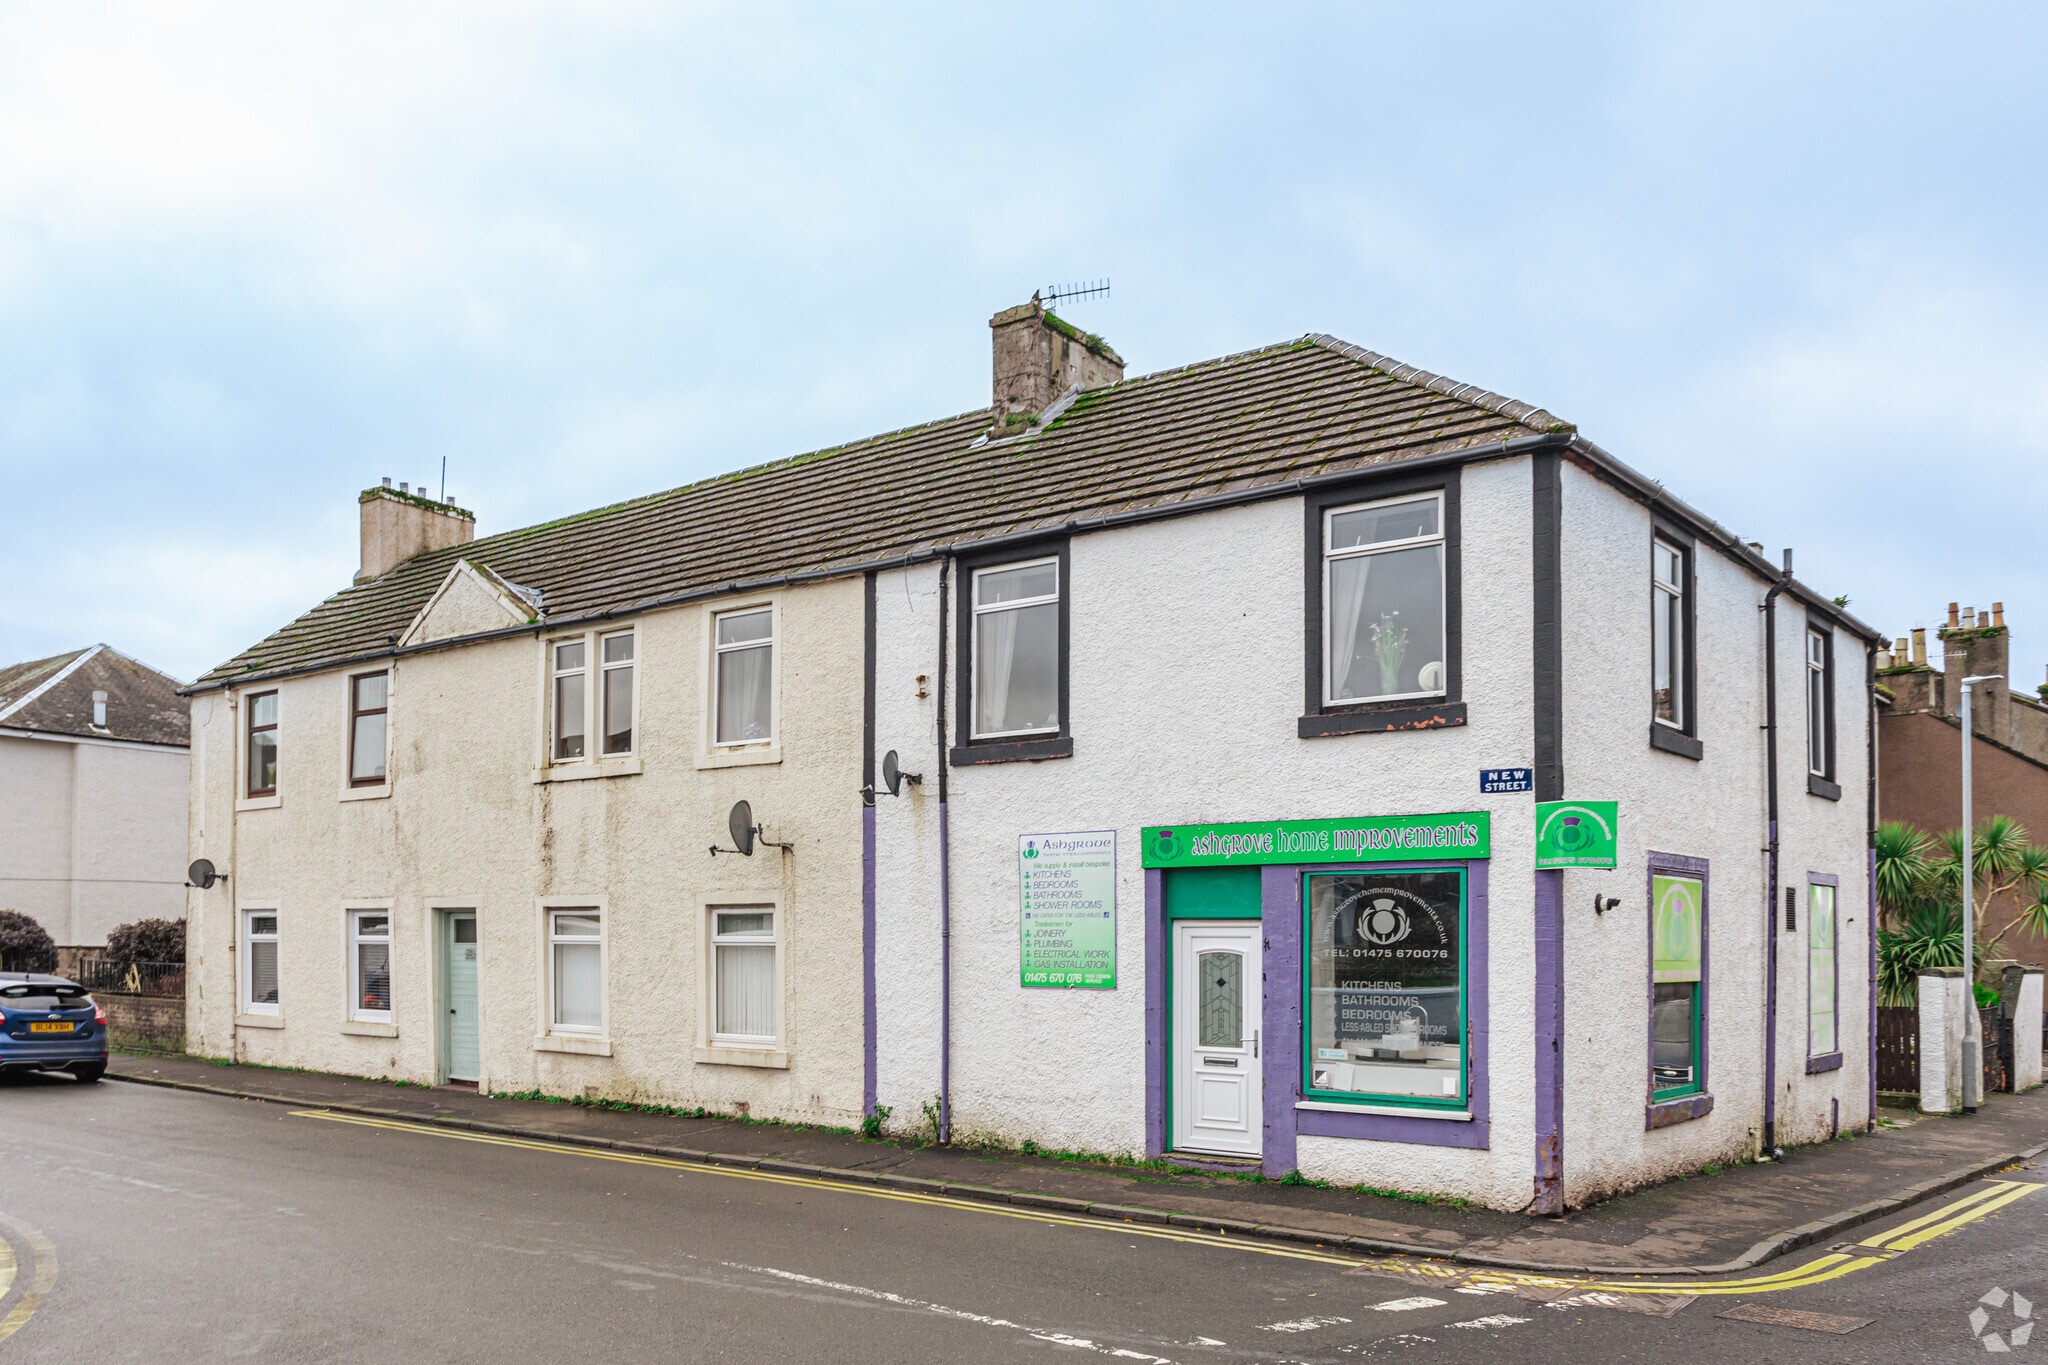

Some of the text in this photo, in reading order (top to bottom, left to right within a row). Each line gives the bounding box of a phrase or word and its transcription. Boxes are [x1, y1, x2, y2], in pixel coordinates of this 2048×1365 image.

[1488, 771, 1525, 781] NEW
[1191, 821, 1478, 859] ashgrove home improvements
[1042, 839, 1111, 852] Ashgrove
[1033, 870, 1072, 879] KITCHENS
[1033, 880, 1079, 889] BEDROOMS
[1033, 890, 1083, 899] BATHROOMS
[1033, 900, 1103, 909] SHOWER ROOMS
[1033, 929, 1067, 938] JOINERY
[1033, 940, 1073, 948] PLUMBING
[1033, 950, 1111, 958] ELECTRICAL WORK
[1323, 949, 1448, 959] TEL: 01475 670076
[1034, 960, 1109, 969] GAS INSTALLATION
[1024, 973, 1082, 983] 01475 670 076
[1341, 980, 1402, 991] KITCHENS
[1341, 995, 1419, 1007] BATHROOMS
[1341, 1009, 1412, 1021] BEDROOMS
[1420, 1024, 1447, 1035] ROOMS
